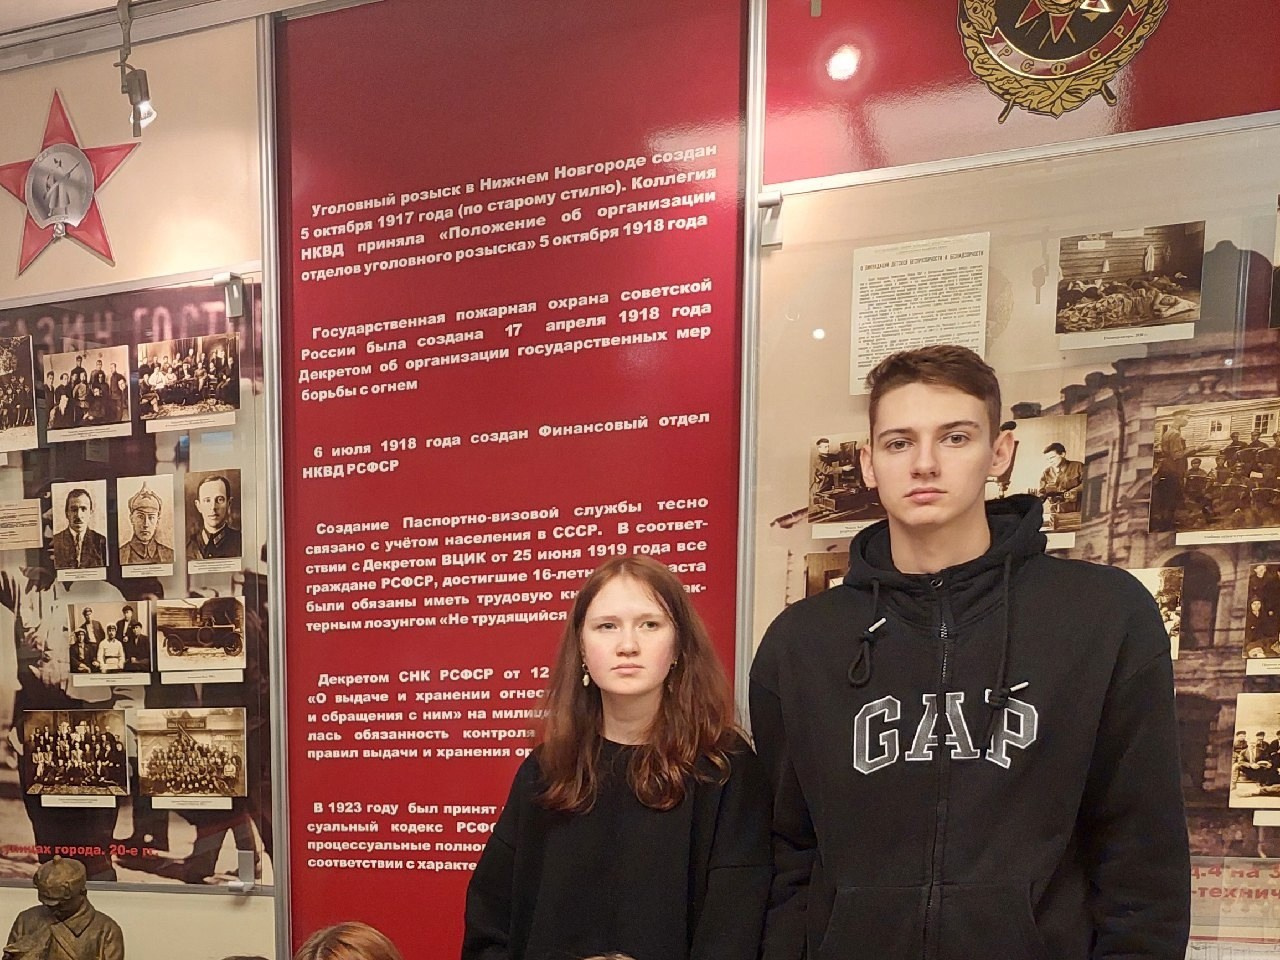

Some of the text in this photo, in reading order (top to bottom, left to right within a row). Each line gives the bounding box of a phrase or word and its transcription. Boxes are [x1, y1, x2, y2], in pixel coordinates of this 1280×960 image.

[312, 145, 716, 217] Уголовный розыск в Нижнем Новгороде создан
[300, 168, 716, 240] 5 октября 1917 года (по старому стилю). Коллегия
[301, 192, 716, 261] НКВД приняла «Положение об организации
[301, 215, 708, 282] отделов уголовного розыска» 5 октября 1918 года
[312, 277, 712, 340] Государственная пожарная охрана советской
[301, 303, 712, 361] России была создана 17 апреля 1918 года
[298, 326, 711, 384] Декретом об организации государственных мер
[301, 380, 418, 402] борьбы с огнем
[313, 413, 710, 458] 6 июля 1918 года создан Финансовый отдел
[302, 459, 399, 479] НКВД РСФСР
[316, 498, 709, 535] Создание Паспортно-визовой службы тесно
[305, 519, 708, 555] связано с учётом населения в СССР. В соответ-
[305, 540, 707, 575] ствии с Декретом ВЦИК от 25 июня 1919 года все
[306, 581, 377, 596] граждане
[381, 575, 438, 589] РСФСР,
[442, 572, 528, 588] достигшие
[306, 601, 345, 613] были
[351, 598, 417, 610] обязаны
[424, 596, 470, 607] иметь
[476, 591, 553, 606] трудовую
[306, 609, 568, 633] терным лозунгом «Не трудящийся
[318, 666, 550, 687] Декретом СНК РСФСР от 12
[307, 689, 550, 705] «О выдаче и хранении огнес
[307, 714, 317, 722] и
[321, 710, 403, 725] обращения
[408, 711, 417, 720] с
[422, 711, 462, 720] ним»
[467, 710, 487, 719] на
[307, 728, 535, 741] лась обязанность контроля
[852, 688, 1039, 775] GAP
[307, 749, 359, 761] правил
[363, 749, 418, 760] выдачи
[422, 749, 432, 757] и
[436, 748, 511, 760] хранения
[313, 801, 497, 817] В 1923 году был принят
[307, 820, 379, 834] суальный
[391, 823, 444, 834] кодекс
[55, 845, 105, 857] города.
[109, 844, 138, 857] 20-е
[307, 841, 431, 853] процессуальные
[307, 859, 404, 869] соответствии
[406, 860, 415, 869] с
